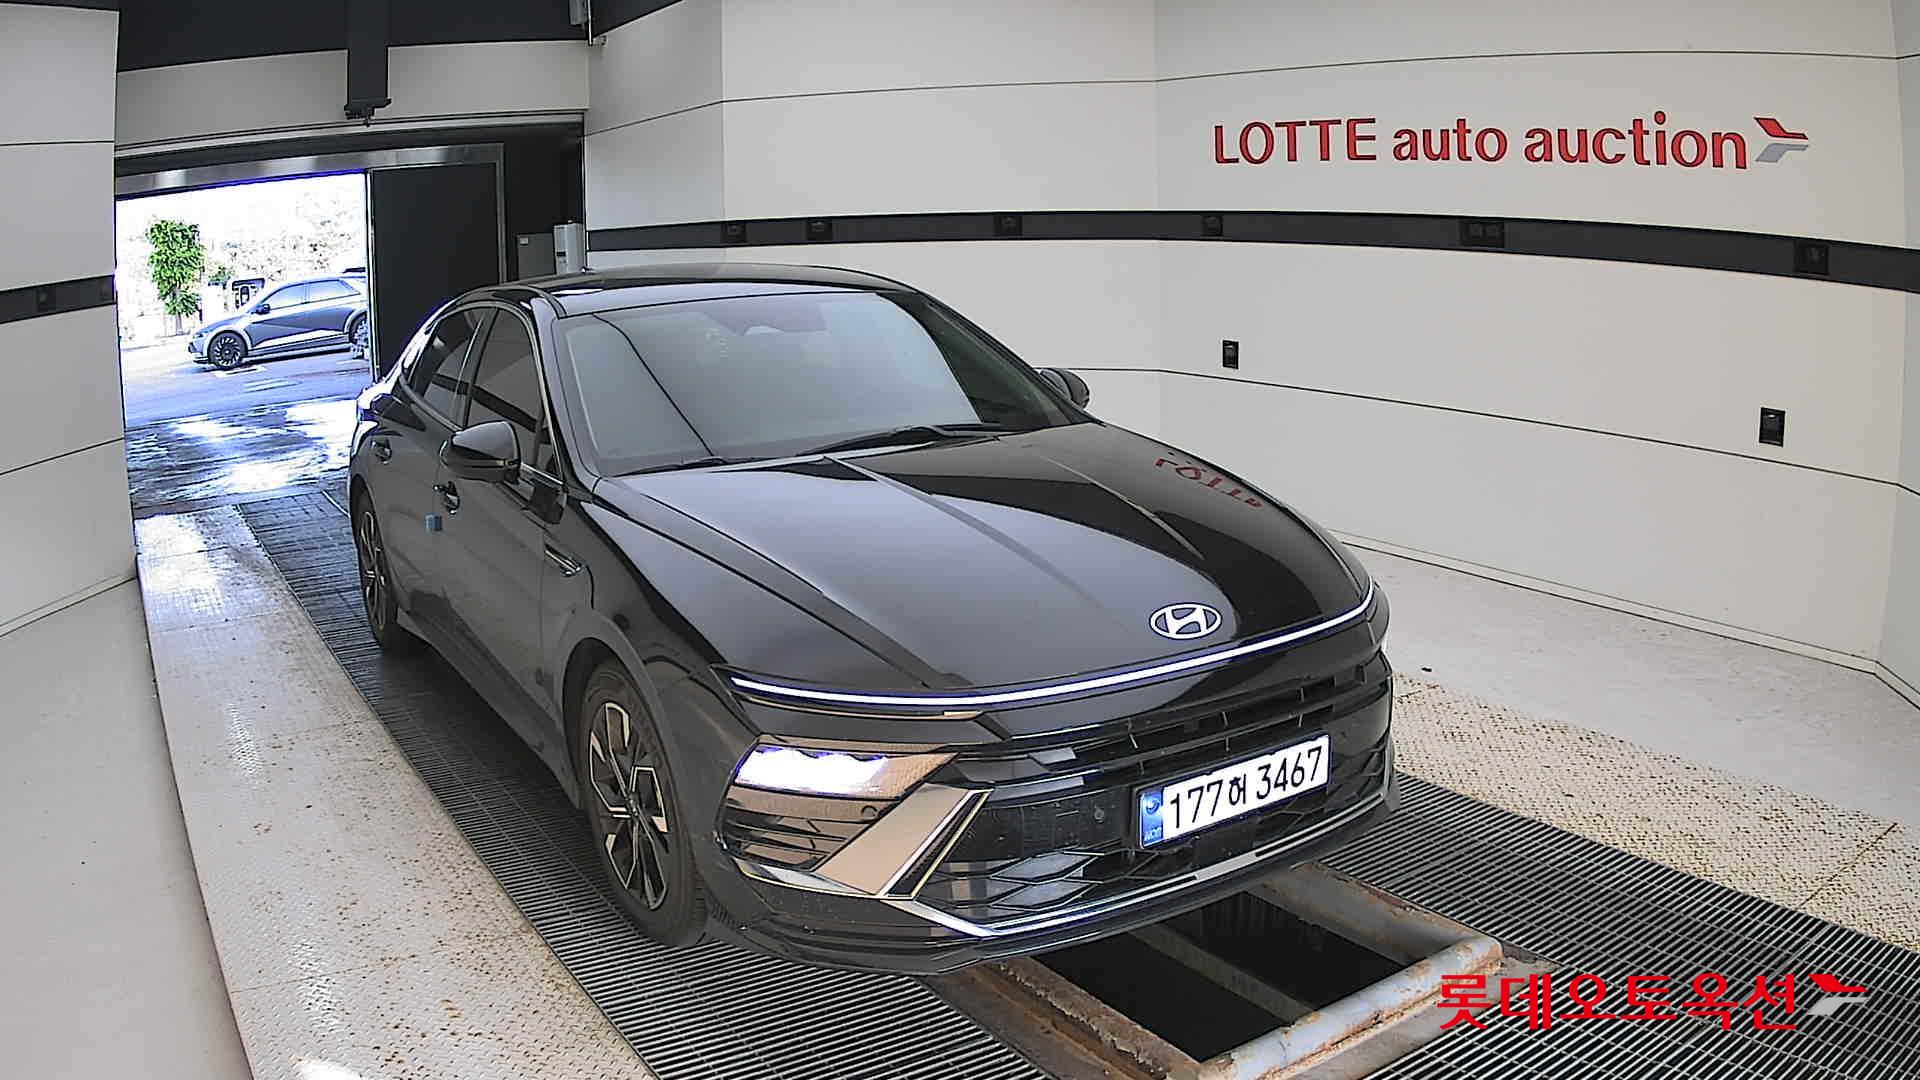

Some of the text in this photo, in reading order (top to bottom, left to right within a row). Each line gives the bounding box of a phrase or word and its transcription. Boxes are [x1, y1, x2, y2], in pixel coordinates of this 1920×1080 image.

[1214, 110, 1748, 170] LOTTE auto auction
[1256, 745, 1322, 800] 3467
